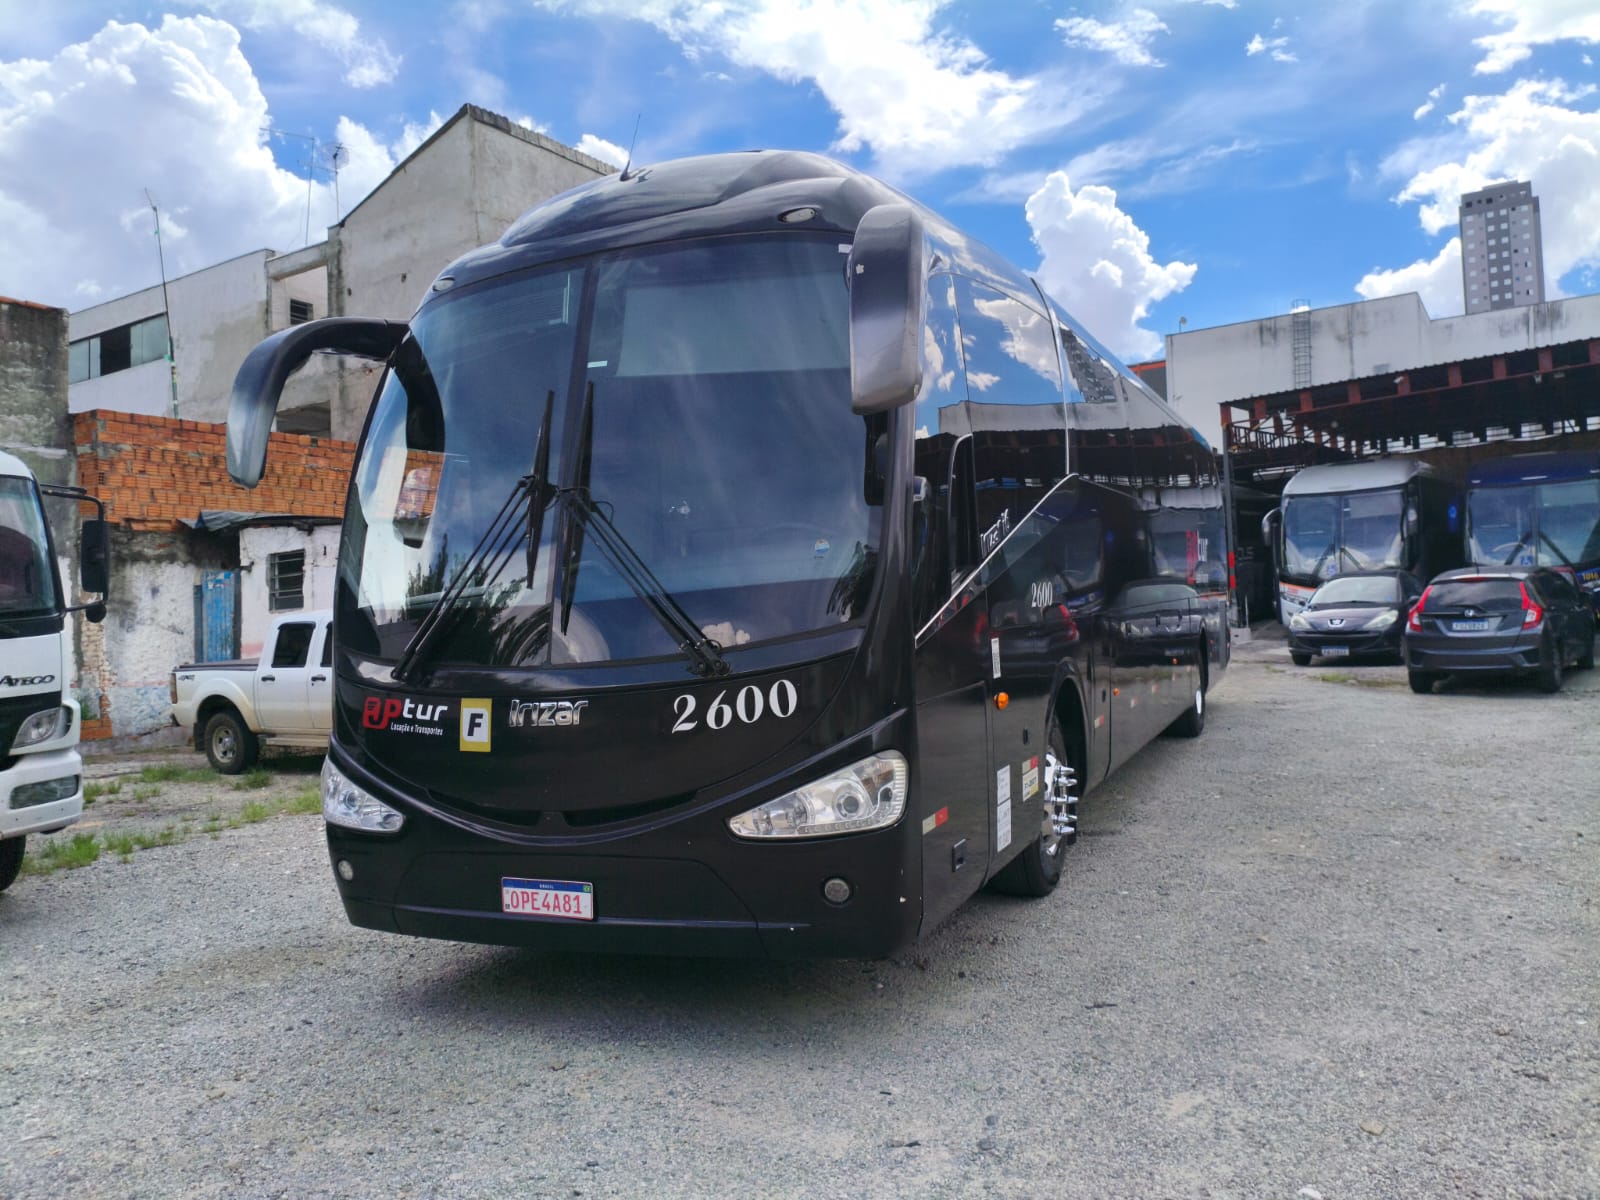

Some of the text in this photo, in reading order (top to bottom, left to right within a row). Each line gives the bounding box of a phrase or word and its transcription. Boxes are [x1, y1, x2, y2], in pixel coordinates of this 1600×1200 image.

[1031, 581, 1053, 608] 2600
[671, 679, 798, 734] 2600
[390, 721, 410, 734] Locação
[414, 724, 444, 736] Transportes
[467, 713, 484, 737] F
[510, 890, 582, 914] OPE4A81
